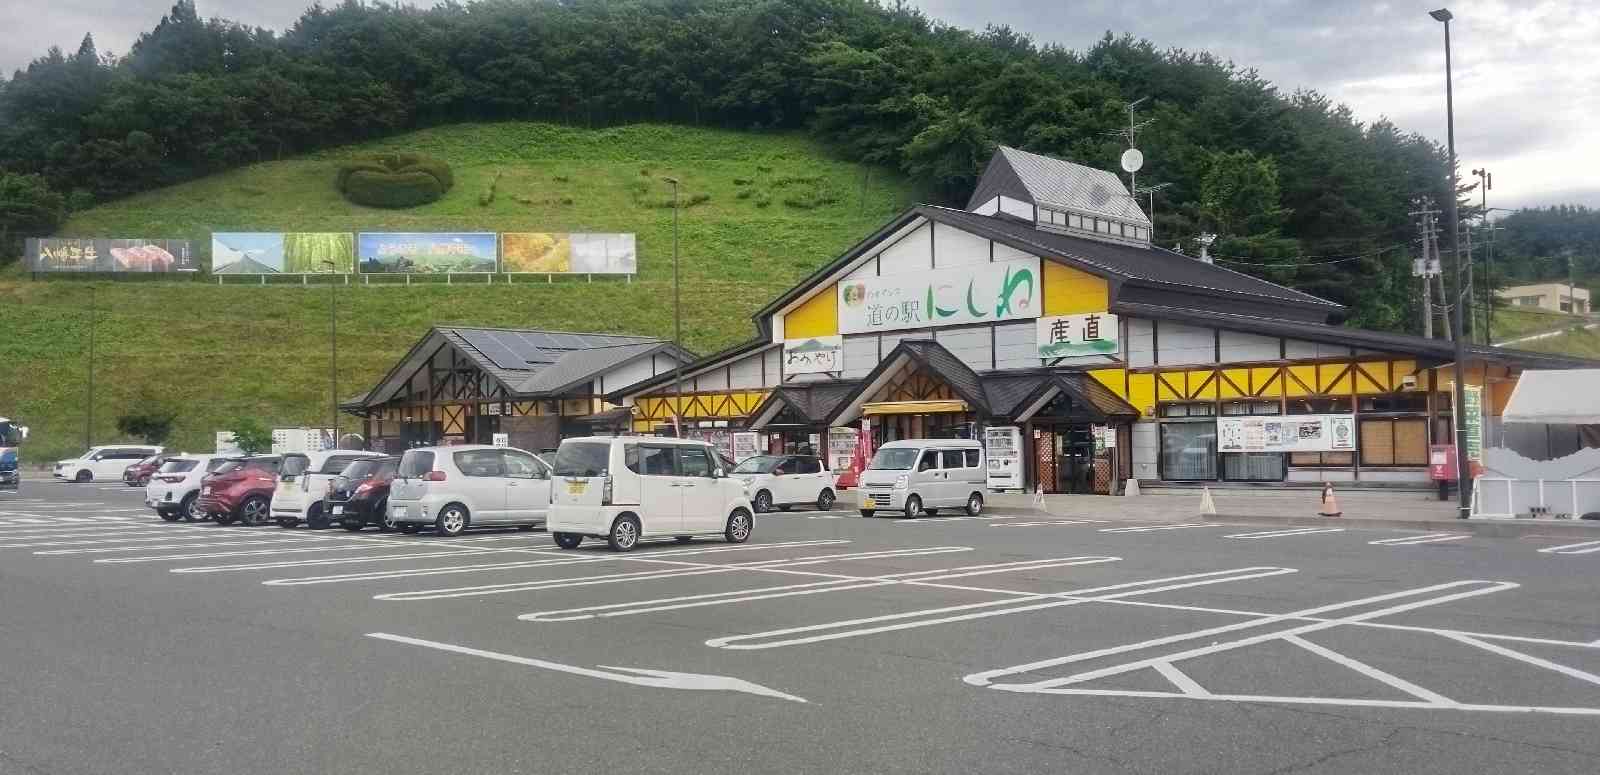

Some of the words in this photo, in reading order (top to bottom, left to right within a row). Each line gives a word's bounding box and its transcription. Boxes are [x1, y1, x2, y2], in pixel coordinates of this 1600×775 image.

[866, 301, 921, 327] 道の駅
[1050, 313, 1104, 344] 産直
